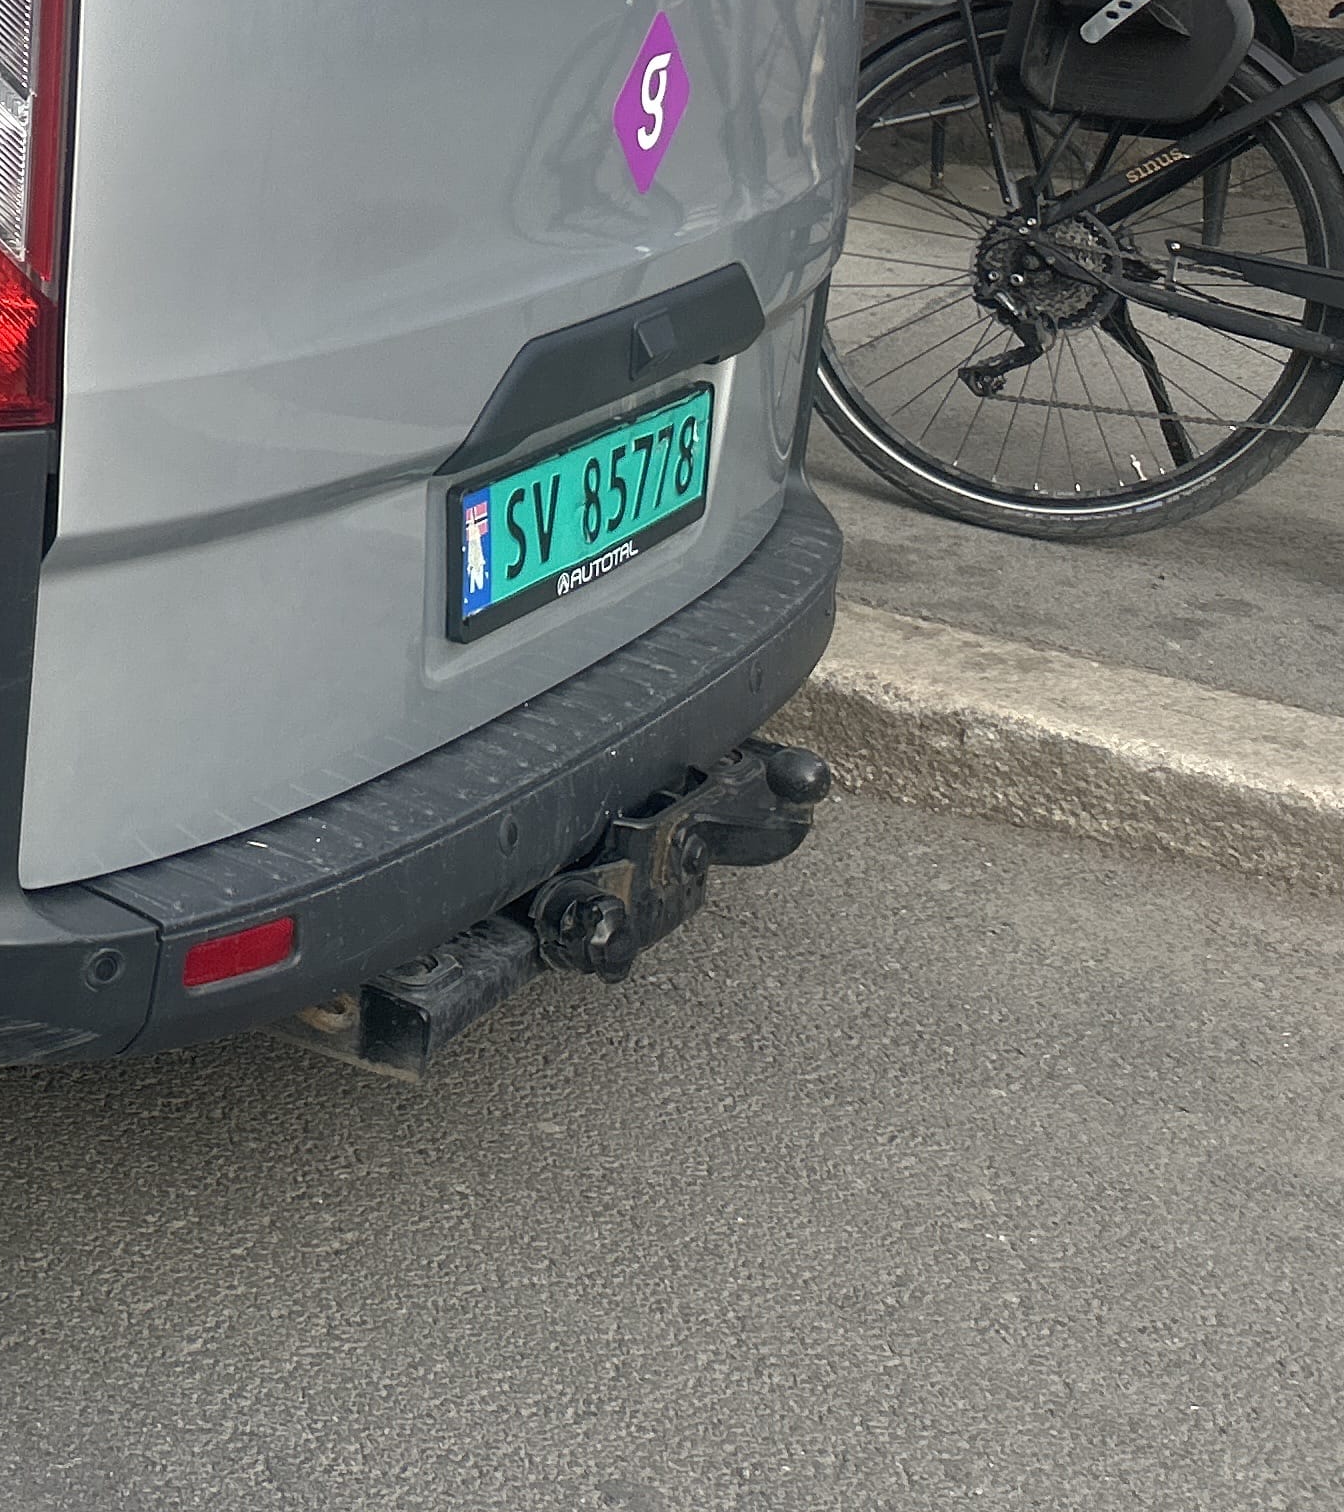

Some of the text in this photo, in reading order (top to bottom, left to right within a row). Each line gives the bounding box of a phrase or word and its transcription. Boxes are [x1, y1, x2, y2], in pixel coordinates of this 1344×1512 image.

[1125, 148, 1183, 183] sinus
[505, 414, 699, 580] SV 85778
[569, 539, 639, 589] AUTOTAL
